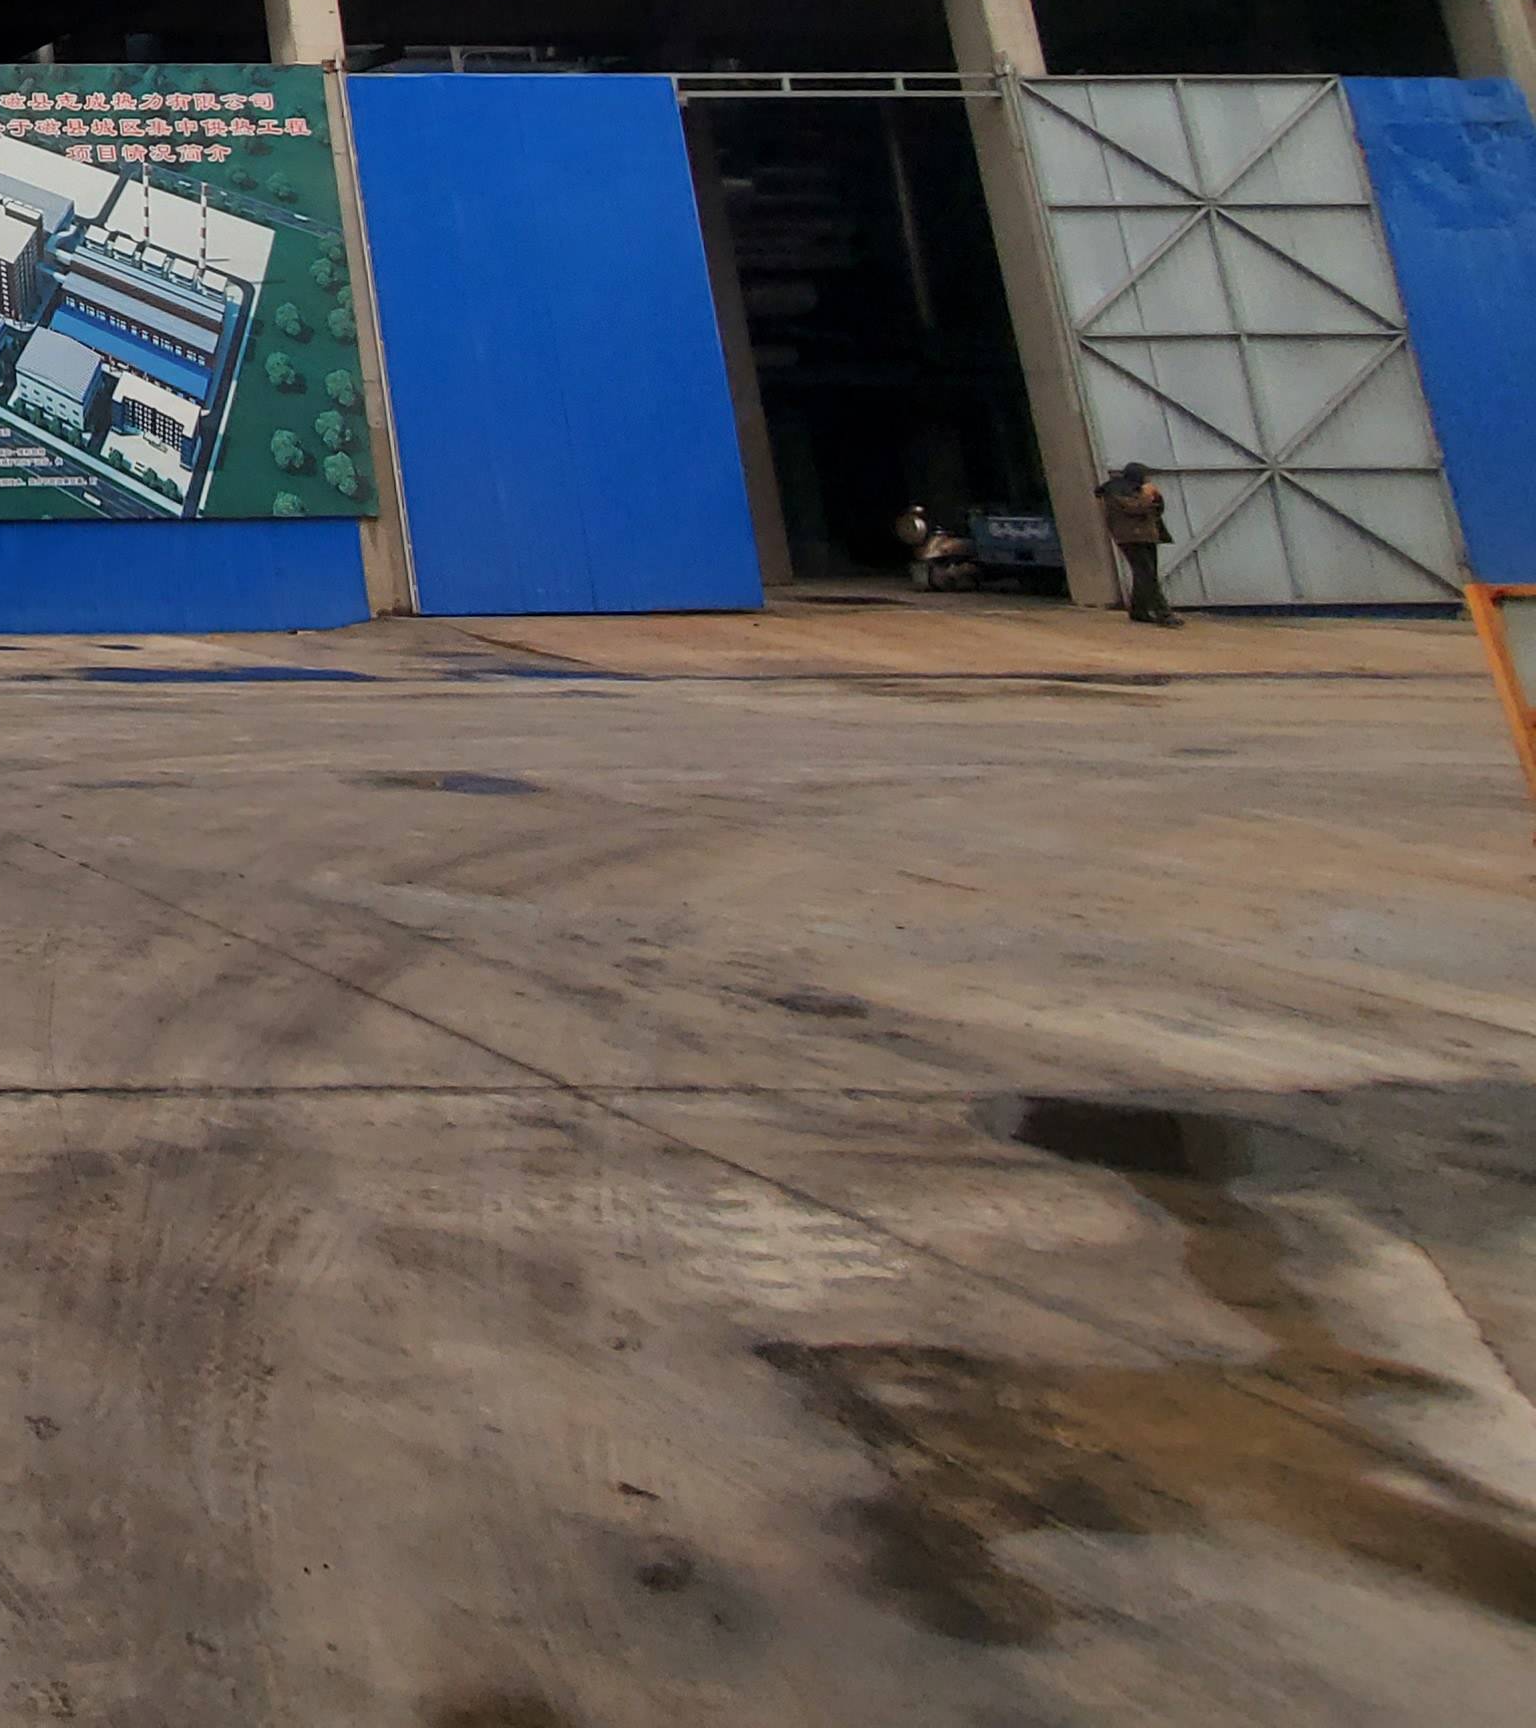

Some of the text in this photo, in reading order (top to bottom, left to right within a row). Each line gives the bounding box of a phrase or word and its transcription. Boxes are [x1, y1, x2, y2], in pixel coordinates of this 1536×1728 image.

[0, 92, 275, 111] 磁县志成热力有限公司
[66, 144, 232, 164] 项目情况简介
